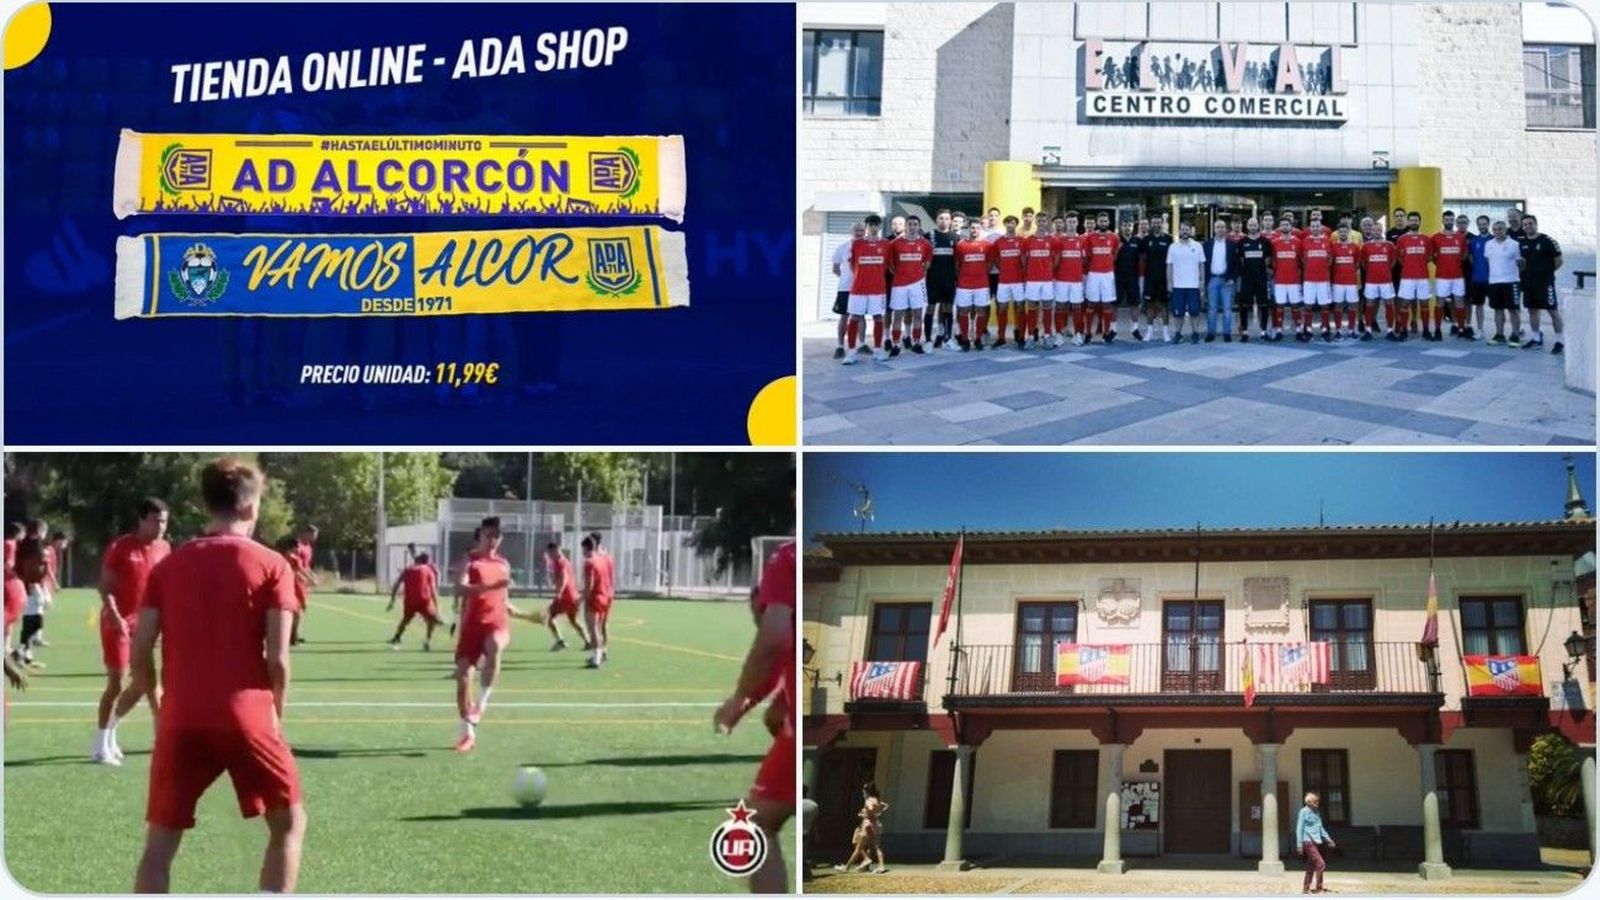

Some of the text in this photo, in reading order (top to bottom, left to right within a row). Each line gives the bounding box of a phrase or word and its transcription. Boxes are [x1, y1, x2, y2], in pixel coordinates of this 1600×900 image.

[1219, 41, 1349, 95] VAL
[1093, 95, 1344, 117] CENTRO COMERCIAL
[321, 137, 482, 151] #HASTAELÚLTIMOMINUTO
[232, 147, 570, 194] AD ALCORCÓN
[242, 232, 580, 292] VAMOS ALCOR
[594, 242, 629, 273] ADA
[361, 296, 452, 312] DESDE 1971
